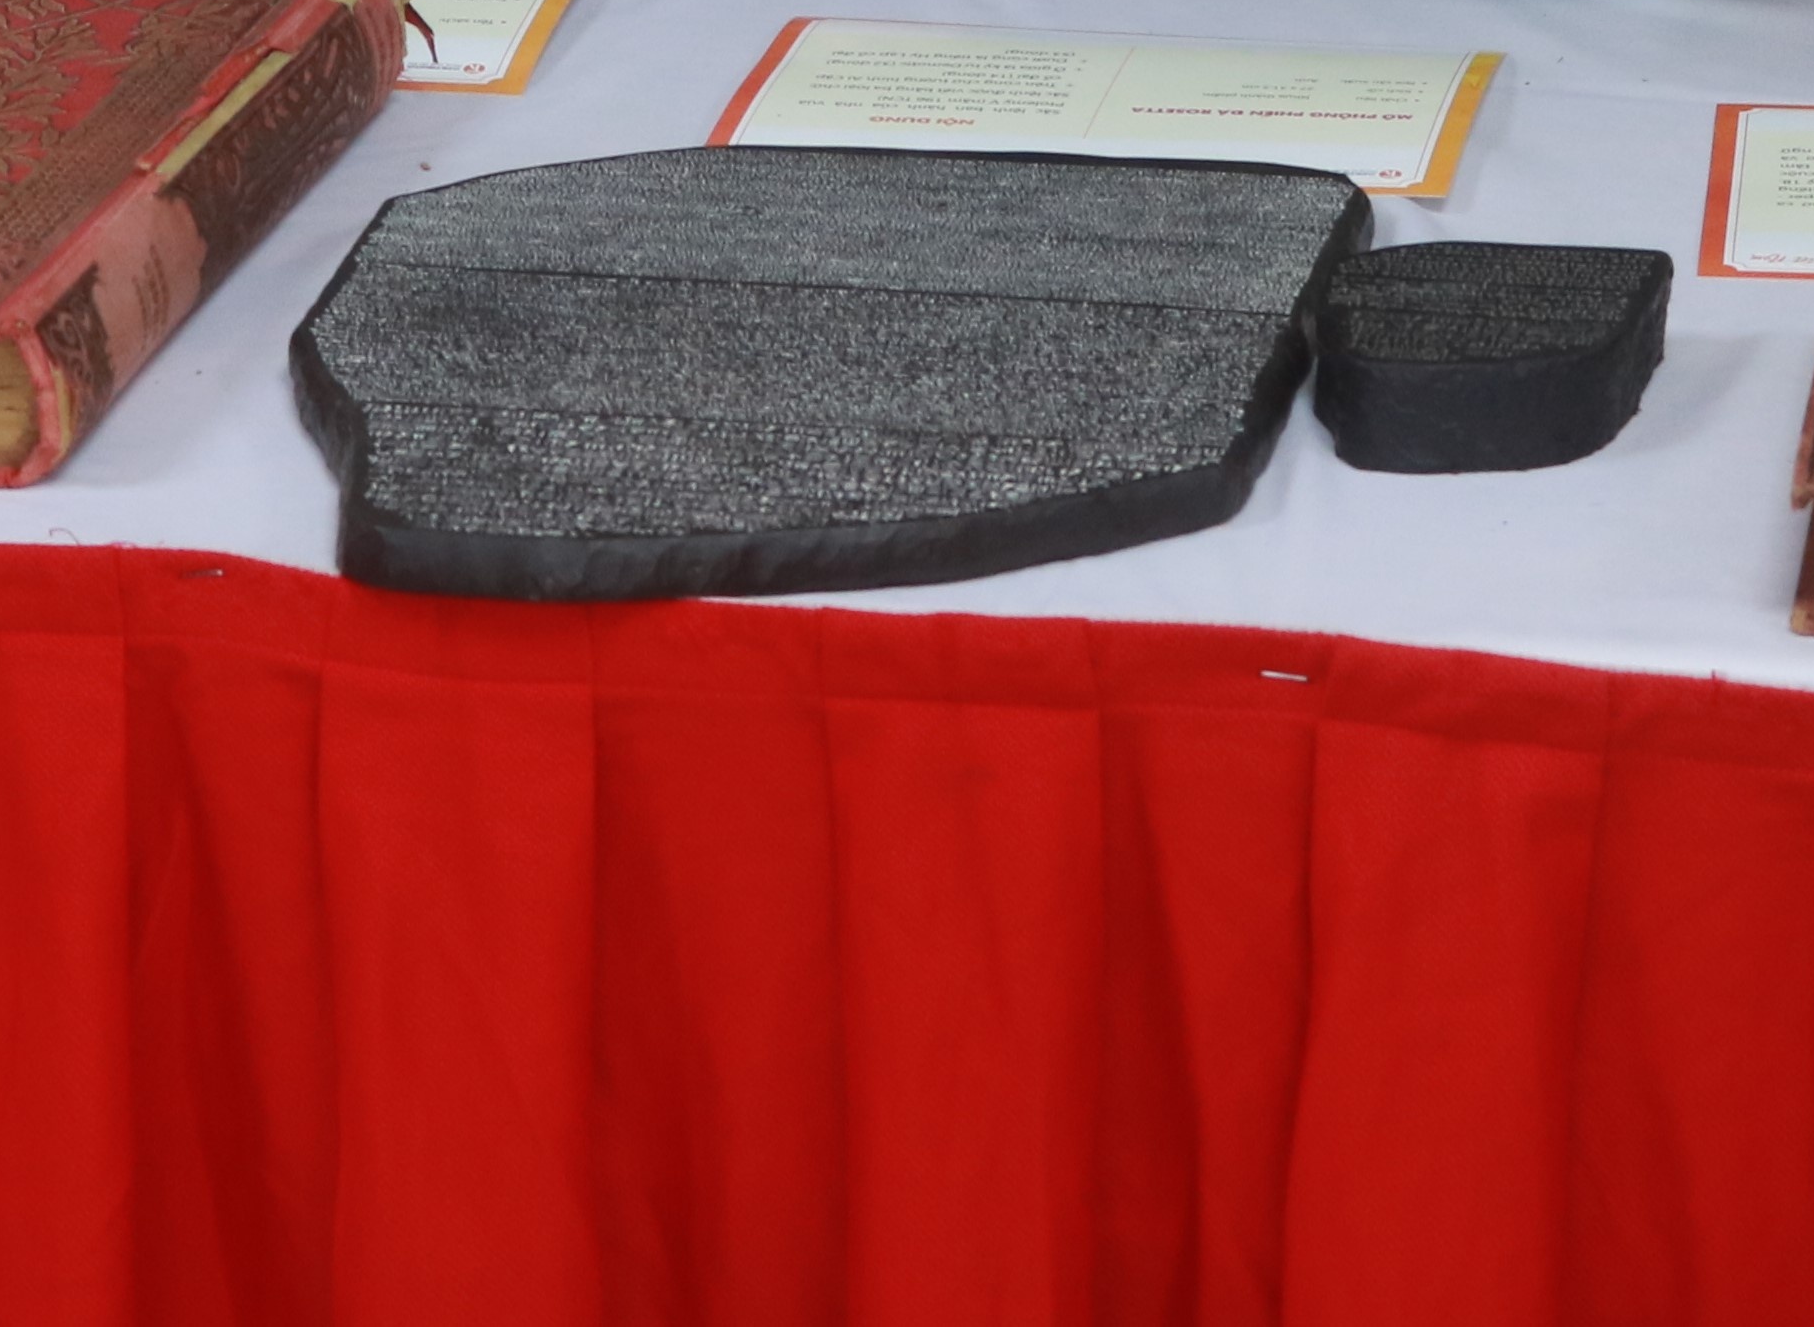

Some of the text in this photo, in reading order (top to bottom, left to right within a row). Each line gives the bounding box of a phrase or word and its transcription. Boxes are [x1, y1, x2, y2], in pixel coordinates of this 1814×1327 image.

[1129, 106, 1413, 121] MÔ PHỎNG PHIẾN ĐÁ ROSETTA
[866, 115, 976, 126] NỘI DUNG
